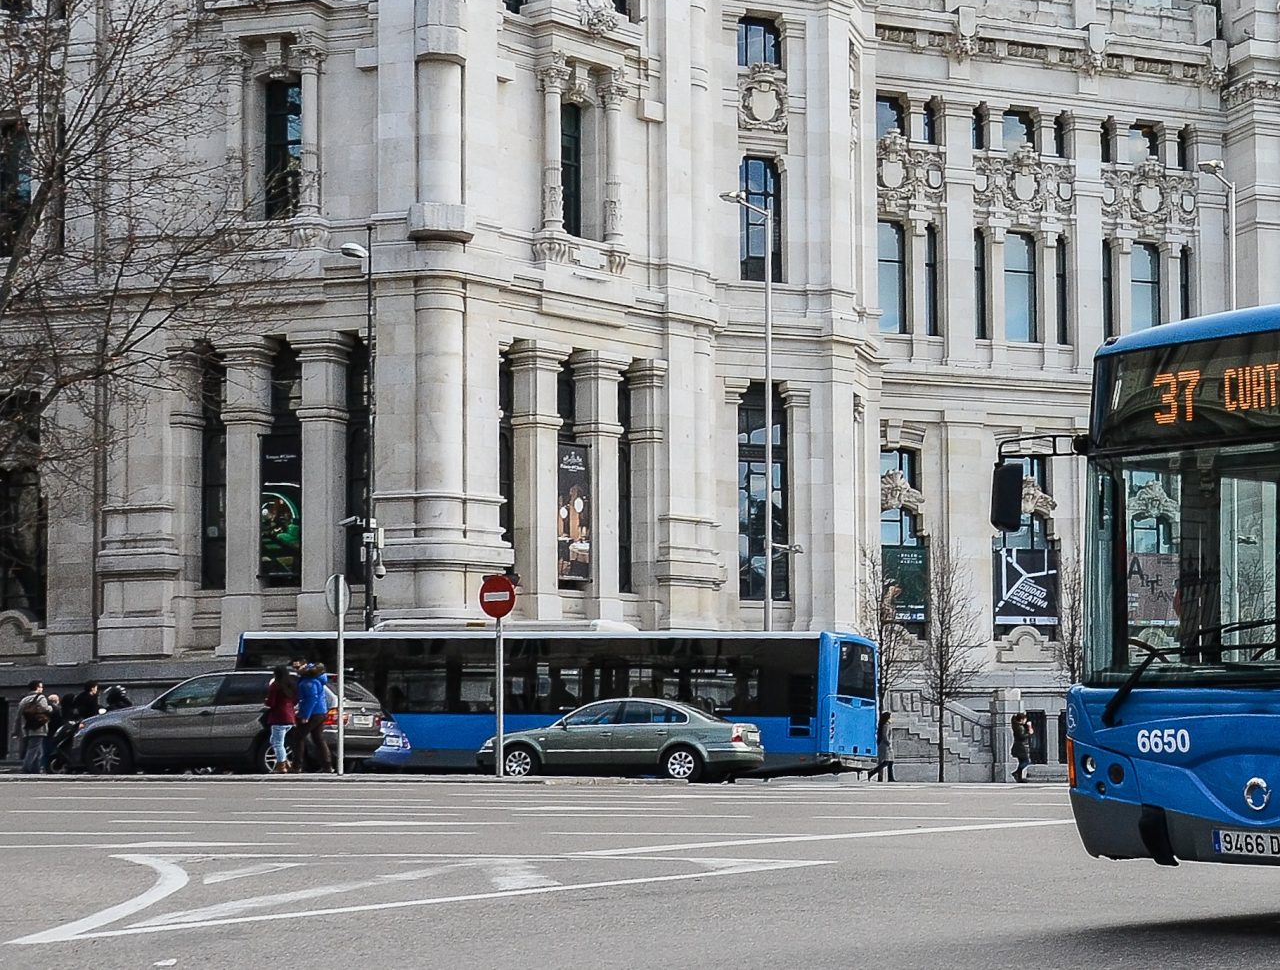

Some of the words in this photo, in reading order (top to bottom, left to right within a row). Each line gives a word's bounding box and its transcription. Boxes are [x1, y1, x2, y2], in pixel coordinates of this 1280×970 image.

[1153, 369, 1201, 425] 37
[1013, 588, 1049, 609] CREATIVA
[1018, 582, 1047, 599] CIUDAD
[1137, 728, 1191, 753] 6650
[1223, 833, 1266, 854] 9466
